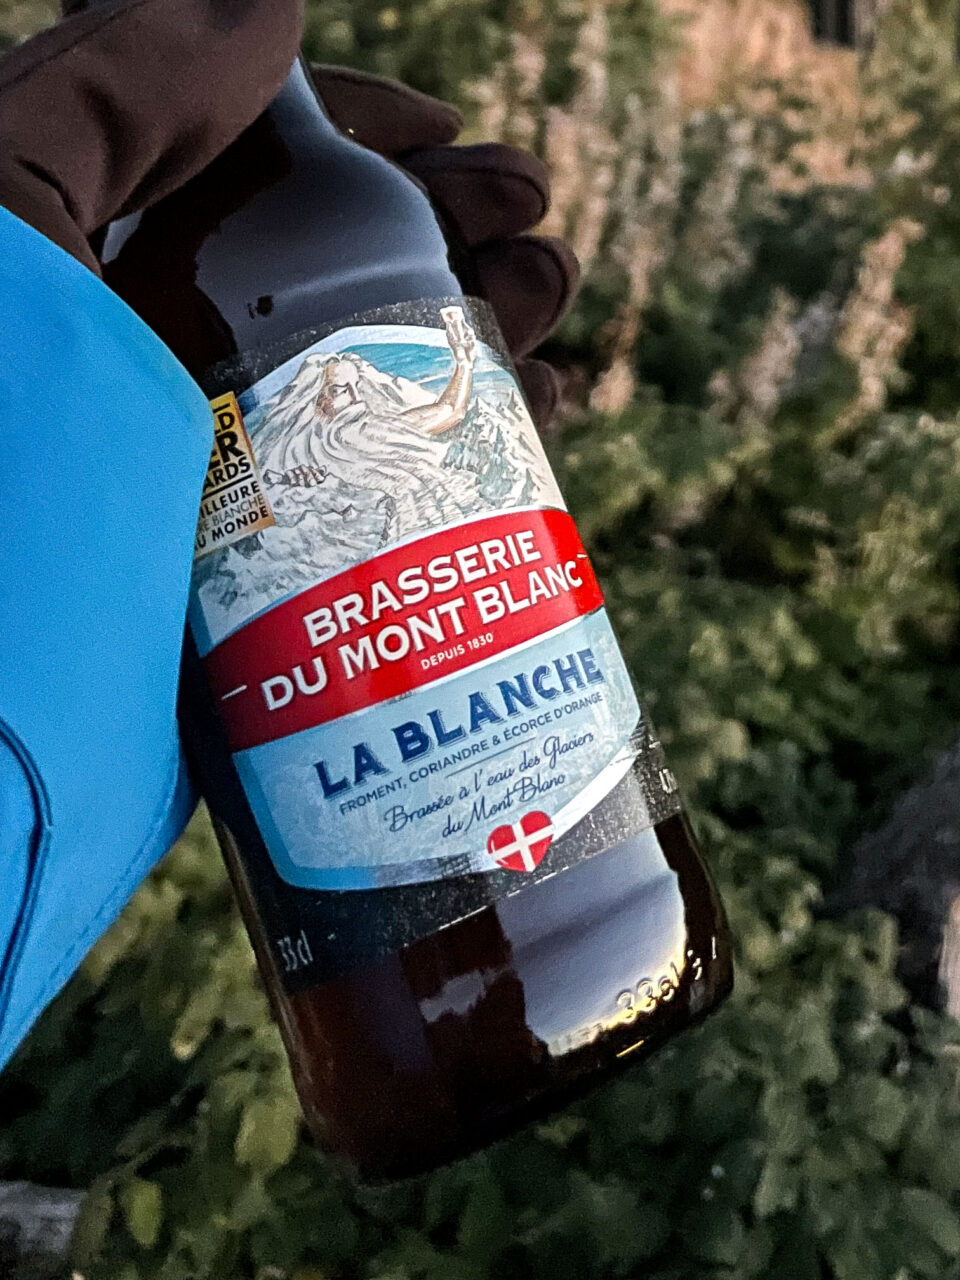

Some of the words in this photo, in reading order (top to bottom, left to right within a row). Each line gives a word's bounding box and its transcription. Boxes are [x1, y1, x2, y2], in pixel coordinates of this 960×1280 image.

[211, 505, 268, 542] MONDE
[212, 493, 264, 527] BLANCHE
[260, 657, 329, 712] DU
[337, 597, 470, 681] MONT
[471, 560, 585, 625] BLANC
[302, 529, 543, 649] BRASSERIE
[420, 644, 466, 671] DEPUIS
[466, 632, 495, 655] 1830
[312, 741, 390, 802] LA
[390, 647, 606, 766] BLANCHE
[339, 774, 408, 817] FROMENT,
[408, 738, 491, 784] CORIANDRE
[491, 734, 502, 746] &
[502, 712, 553, 742] ÉCORCE
[553, 690, 604, 720] D'ORANGE
[383, 791, 455, 833] Brassée
[458, 784, 470, 800] à
[518, 750, 541, 773] des
[542, 731, 594, 770] Glaciers
[442, 815, 464, 838] du
[464, 787, 516, 832] Mont
[513, 773, 566, 803] Blanc
